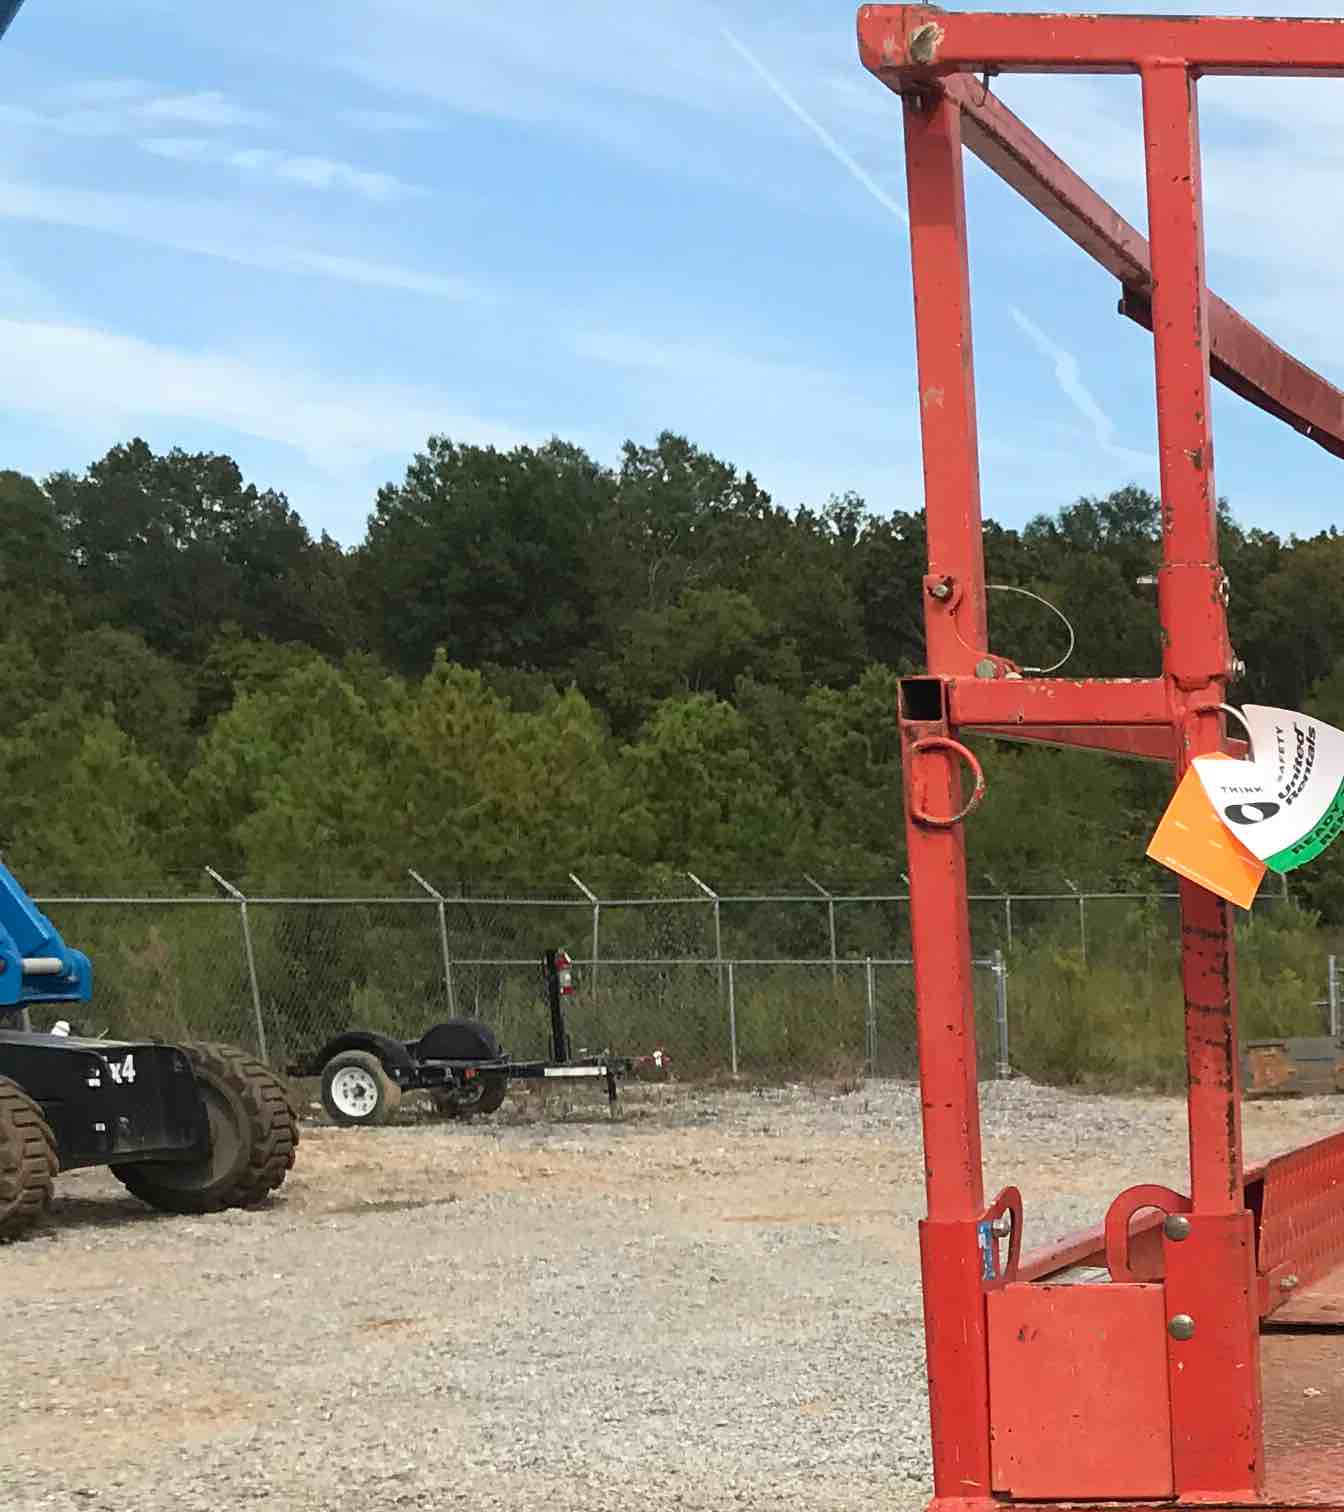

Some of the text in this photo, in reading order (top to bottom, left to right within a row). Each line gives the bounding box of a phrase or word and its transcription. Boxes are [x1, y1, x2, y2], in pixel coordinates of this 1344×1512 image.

[1278, 721, 1305, 800] United
[1285, 726, 1317, 806] Rentals
[1291, 803, 1340, 855] READY
